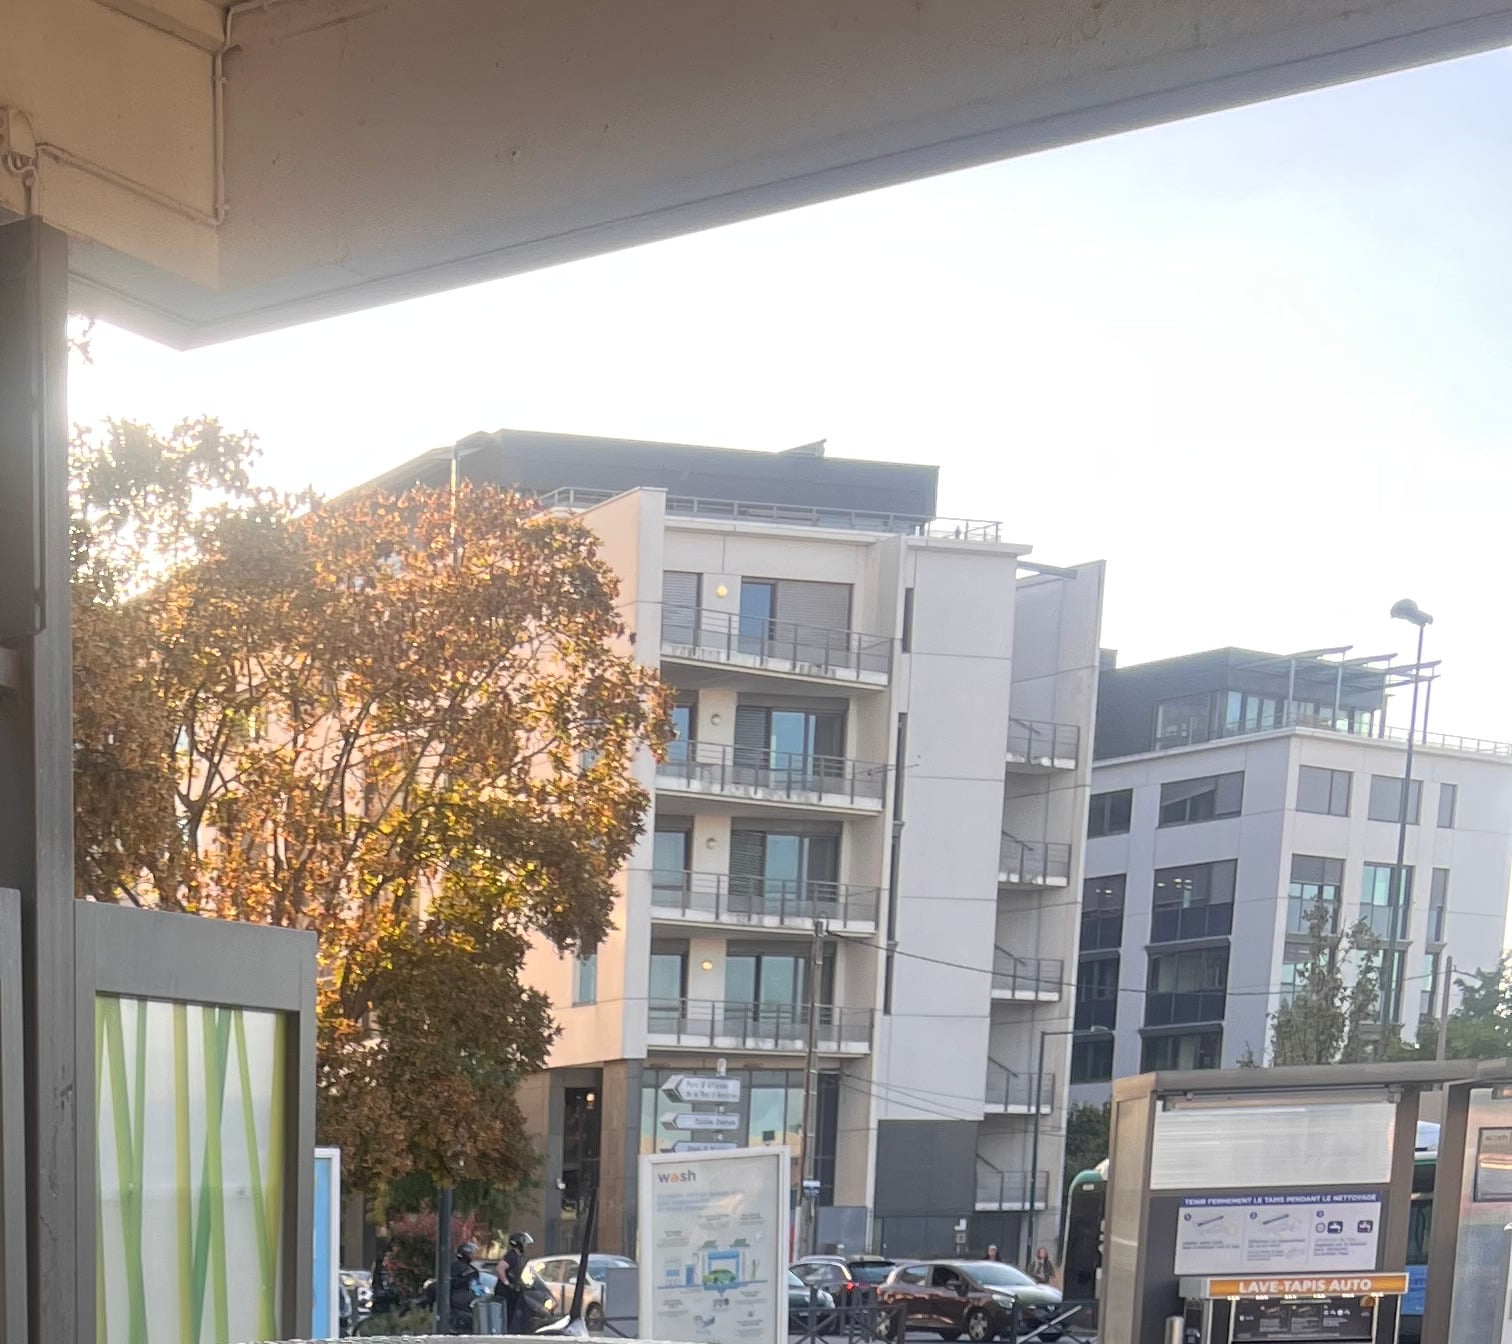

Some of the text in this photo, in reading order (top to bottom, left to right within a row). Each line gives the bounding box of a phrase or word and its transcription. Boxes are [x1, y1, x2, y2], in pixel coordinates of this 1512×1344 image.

[657, 1169, 696, 1183] wash
[1239, 1278, 1372, 1294] LAVE-TAPIS AUTO
